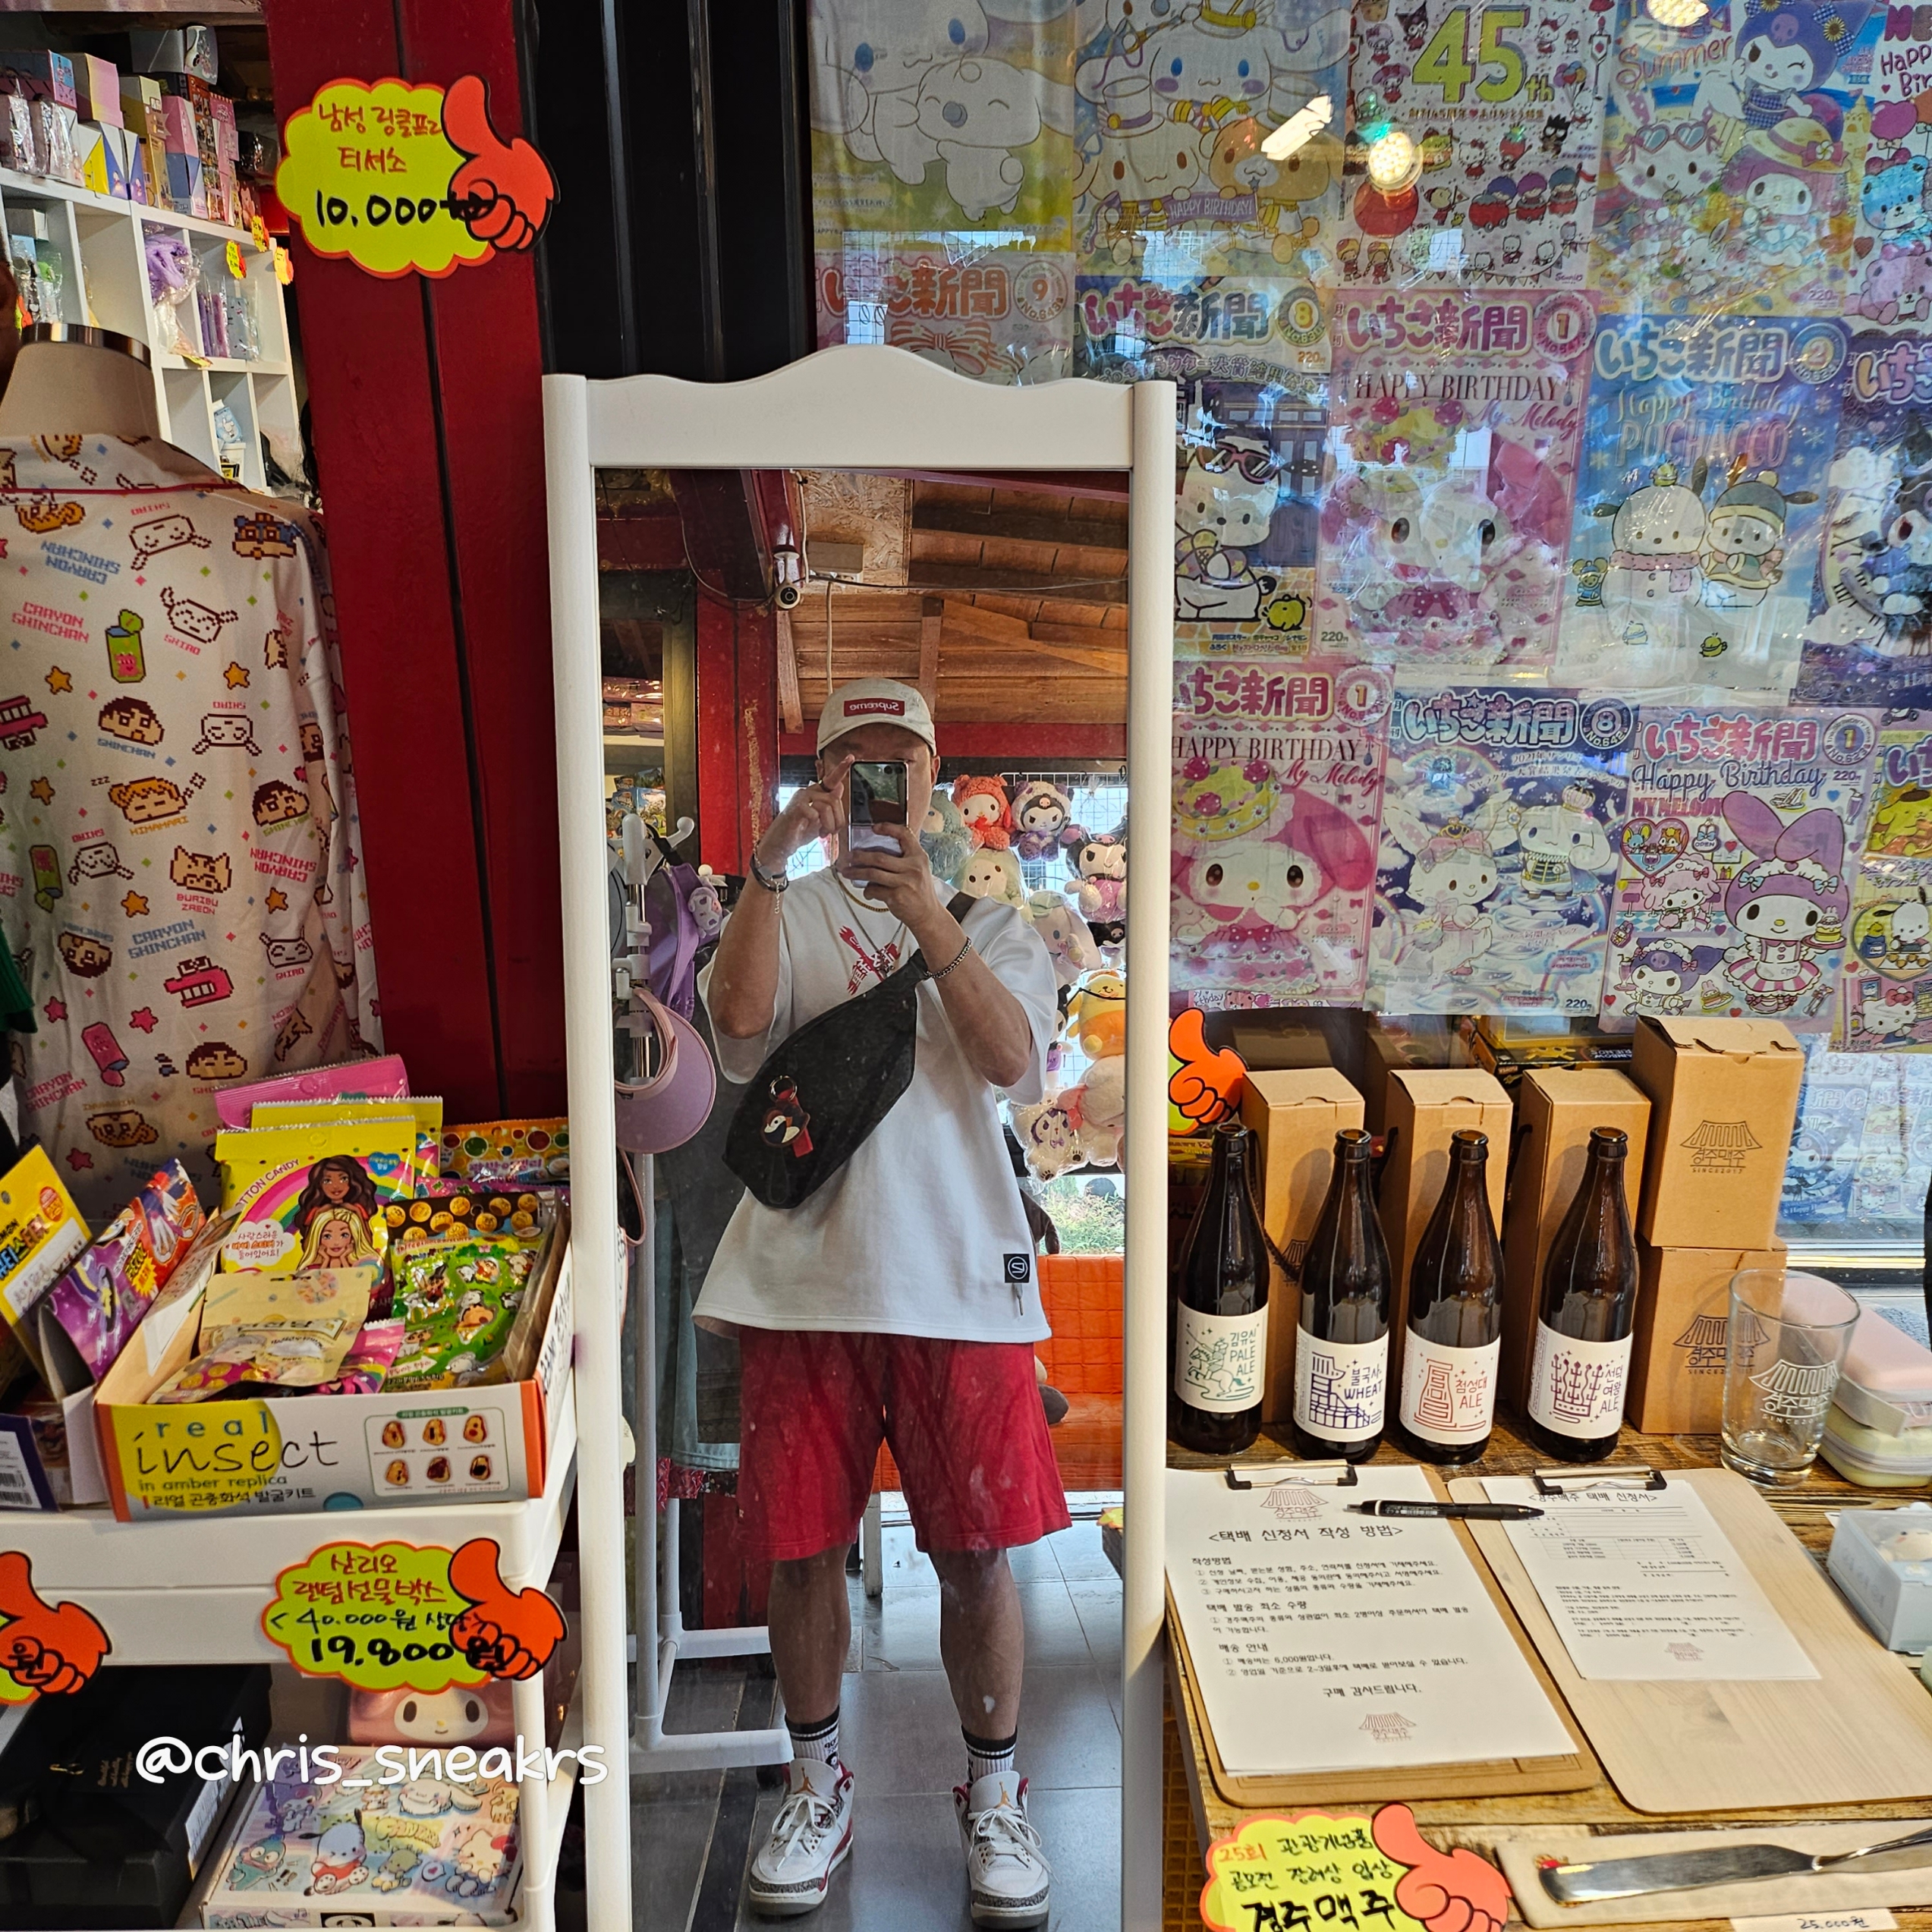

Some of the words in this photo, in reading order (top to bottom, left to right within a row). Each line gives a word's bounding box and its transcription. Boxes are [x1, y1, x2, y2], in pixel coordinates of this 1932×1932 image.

[1616, 35, 1733, 84] Summer
[319, 103, 366, 134] 남성
[1170, 197, 1200, 218] HAPPY
[1204, 197, 1254, 216] BIRTHDAY!
[1031, 278, 1048, 301] 9
[1295, 301, 1314, 329] 8
[1556, 313, 1570, 340] 1
[1598, 320, 1785, 379] いちご新聞
[1808, 341, 1827, 368] 2
[1353, 375, 1436, 400] HAPPY
[1442, 375, 1561, 401] BIRTHDAY
[1507, 402, 1584, 442] Melody
[1616, 420, 1789, 468] POCHACCO
[41, 540, 121, 574] SHINCHAN
[23, 601, 84, 628] CRAYON
[11, 612, 90, 643] SHINCHAN
[1320, 631, 1348, 643] 220円
[1355, 684, 1368, 708] 1
[1405, 691, 1578, 747] いちご新聞
[1596, 710, 1617, 734] 8
[96, 738, 156, 760] SHINCHAN
[1171, 738, 1245, 760] HAPPY
[1249, 738, 1364, 761] BIRTHDAY
[1585, 731, 1626, 747] No.642
[1645, 715, 1819, 762] いちご新聞
[1843, 728, 1857, 750] 1
[1827, 745, 1868, 763] No.623
[1278, 761, 1309, 788] My
[1312, 763, 1383, 797] Melody
[1631, 763, 1712, 802] Happy
[1720, 760, 1824, 798] Birthday
[1832, 770, 1861, 781] 220円
[1632, 798, 1657, 817] MY
[1657, 797, 1725, 817] MELODY
[250, 848, 317, 872] SHINCHAN
[132, 919, 195, 946] CRAYON
[127, 930, 206, 959] SHINCHAN
[1691, 1147, 1746, 1166] 경주맥주
[265, 1158, 300, 1182] CANDY
[238, 1230, 278, 1240] 사랑스러운
[1229, 1328, 1257, 1348] 김유신
[1229, 1345, 1256, 1363] PALE
[1236, 1359, 1256, 1377] ALE
[1351, 1363, 1383, 1386] 불국사
[1343, 1379, 1383, 1400] WHEAT
[1455, 1377, 1487, 1394] 첨성대
[1458, 1392, 1483, 1409] ALE
[1599, 1396, 1620, 1414] ALE
[156, 1411, 269, 1438] real
[134, 1430, 339, 1474] insect
[139, 1479, 156, 1493] in
[162, 1477, 220, 1491] amber
[228, 1474, 288, 1488] replica
[153, 1493, 185, 1506] 리얼
[190, 1491, 250, 1506] 곤충화석
[254, 1487, 316, 1504] 발굴키트
[1274, 1506, 1319, 1518] 경주맥주
[1261, 1528, 1310, 1542] 신청서
[1318, 1526, 1351, 1540] 작성
[331, 1551, 399, 1575] 산리오
[1219, 1644, 1239, 1654] 배송
[1245, 1642, 1269, 1652] 안내
[1323, 1688, 1345, 1698] 구매
[1218, 1843, 1267, 1864] 25회
[1229, 1869, 1279, 1893] 공모전
[1285, 1861, 1342, 1885] 장려상
[1352, 1858, 1395, 1882] 입상
